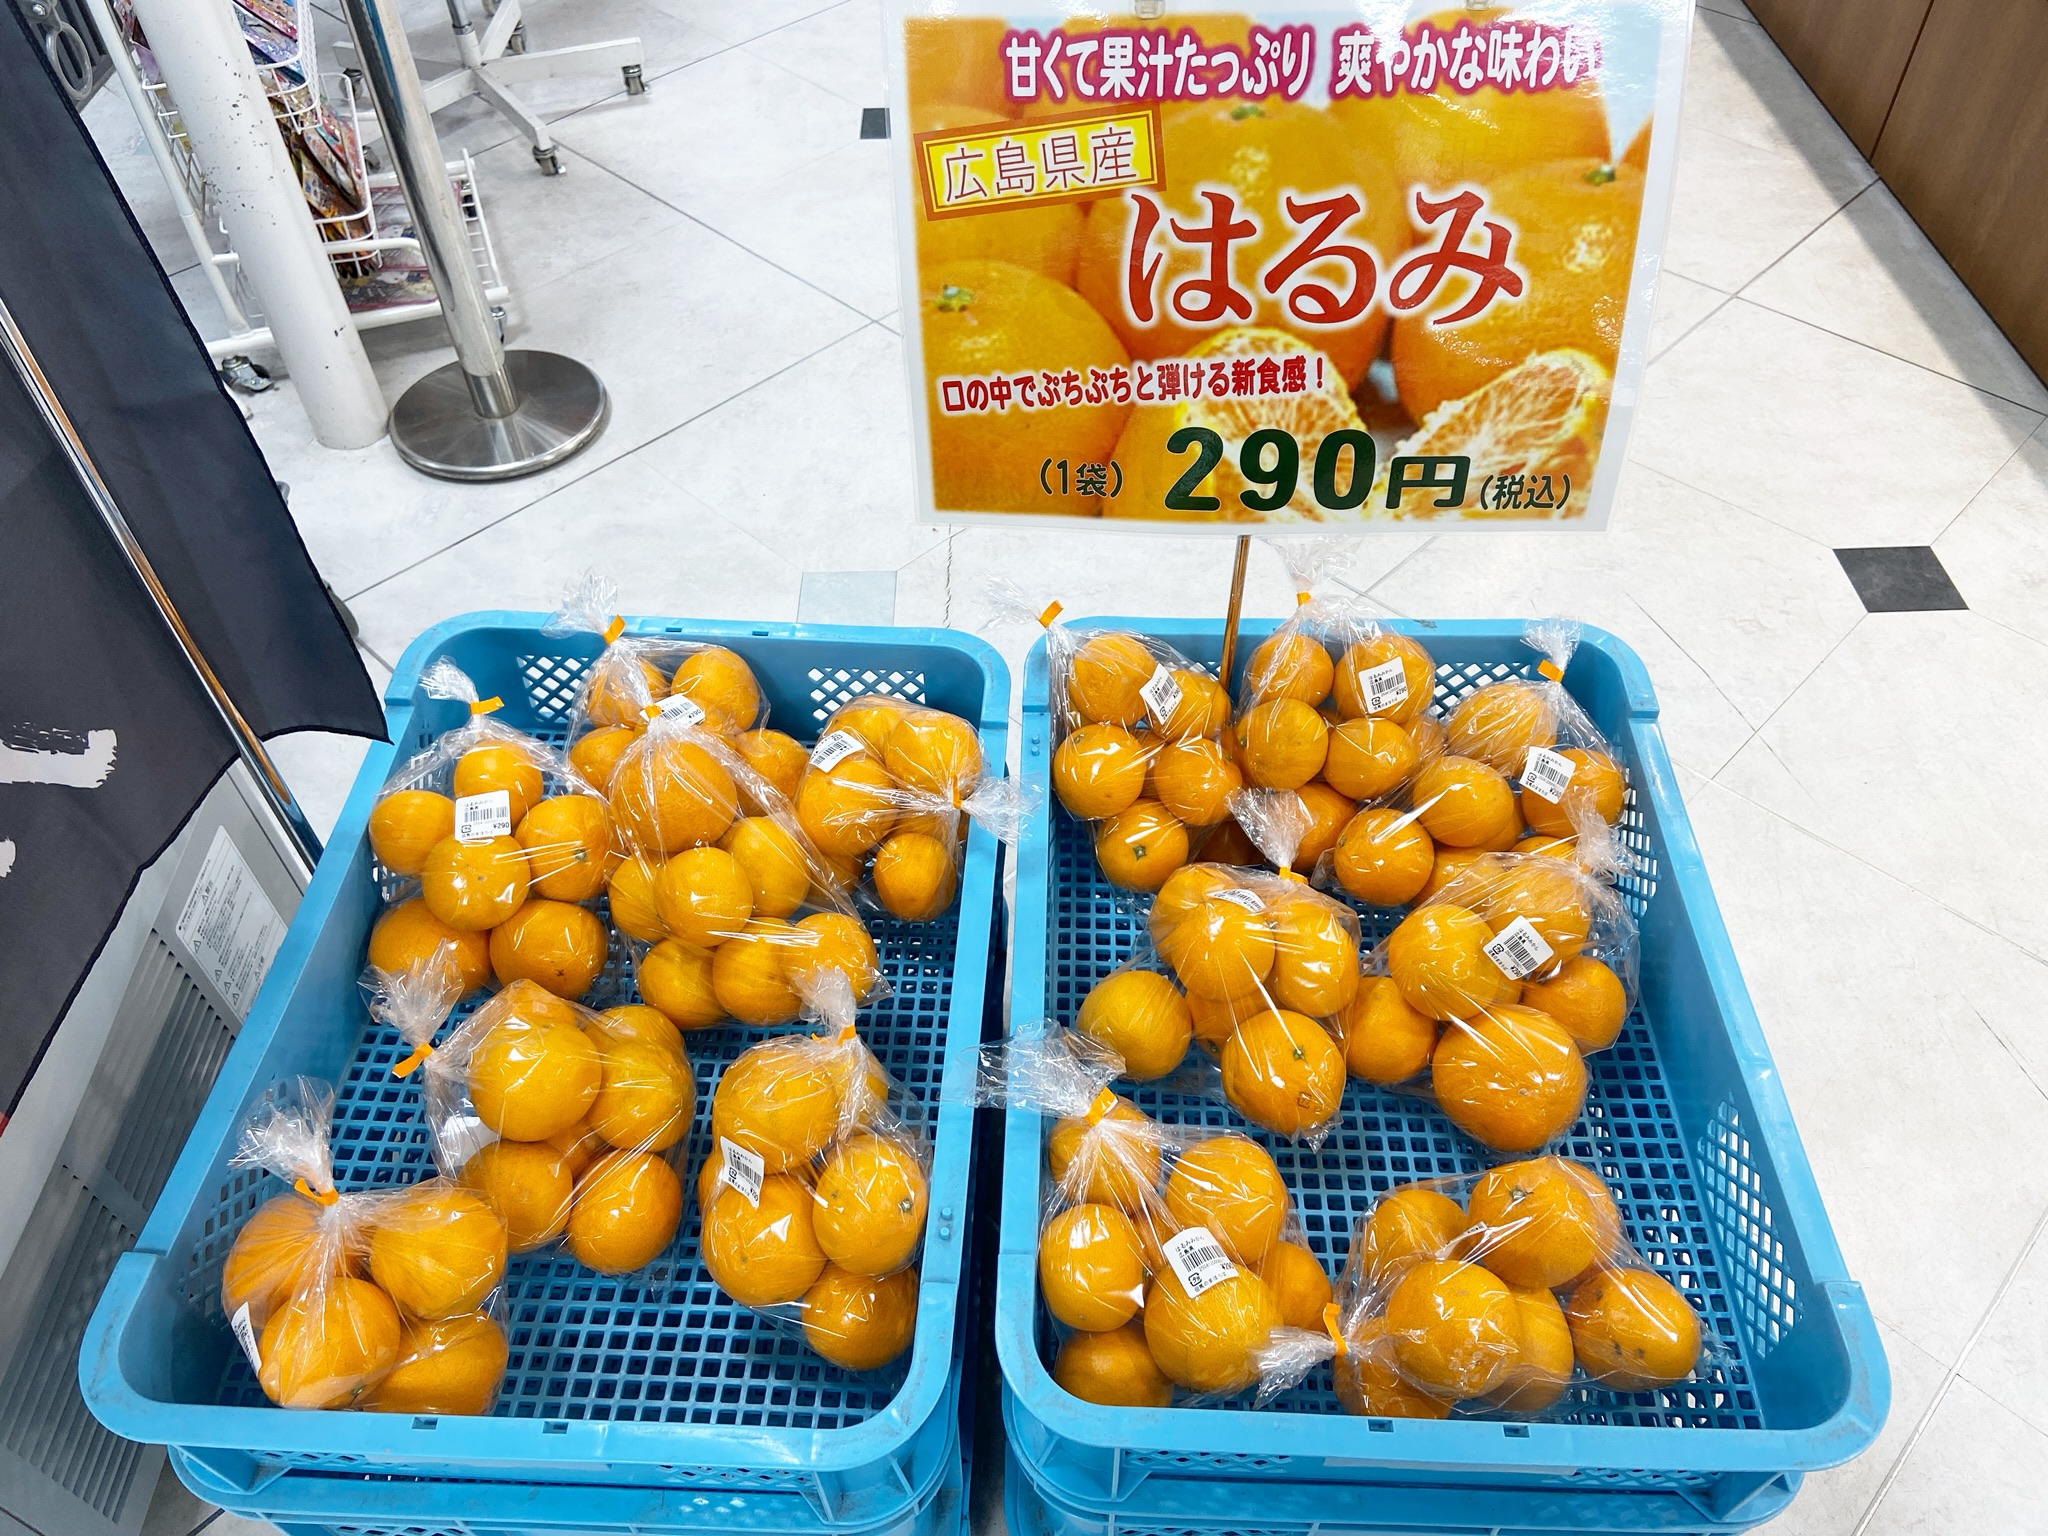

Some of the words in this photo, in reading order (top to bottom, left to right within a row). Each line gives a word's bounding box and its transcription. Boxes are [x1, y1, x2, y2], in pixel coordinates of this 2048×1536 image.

[1005, 31, 1310, 98] 甘くて果汁たっぷり
[1334, 25, 1599, 95] 爽やかな味わい
[945, 126, 1137, 202] 広島県産
[1126, 190, 1523, 325] はるみ
[941, 354, 1324, 412] 口の中でぷちぷちと弾ける新食感！
[1039, 457, 1124, 498] （1袋）
[1163, 426, 1471, 512] 290円
[1479, 473, 1572, 510] （税込）
